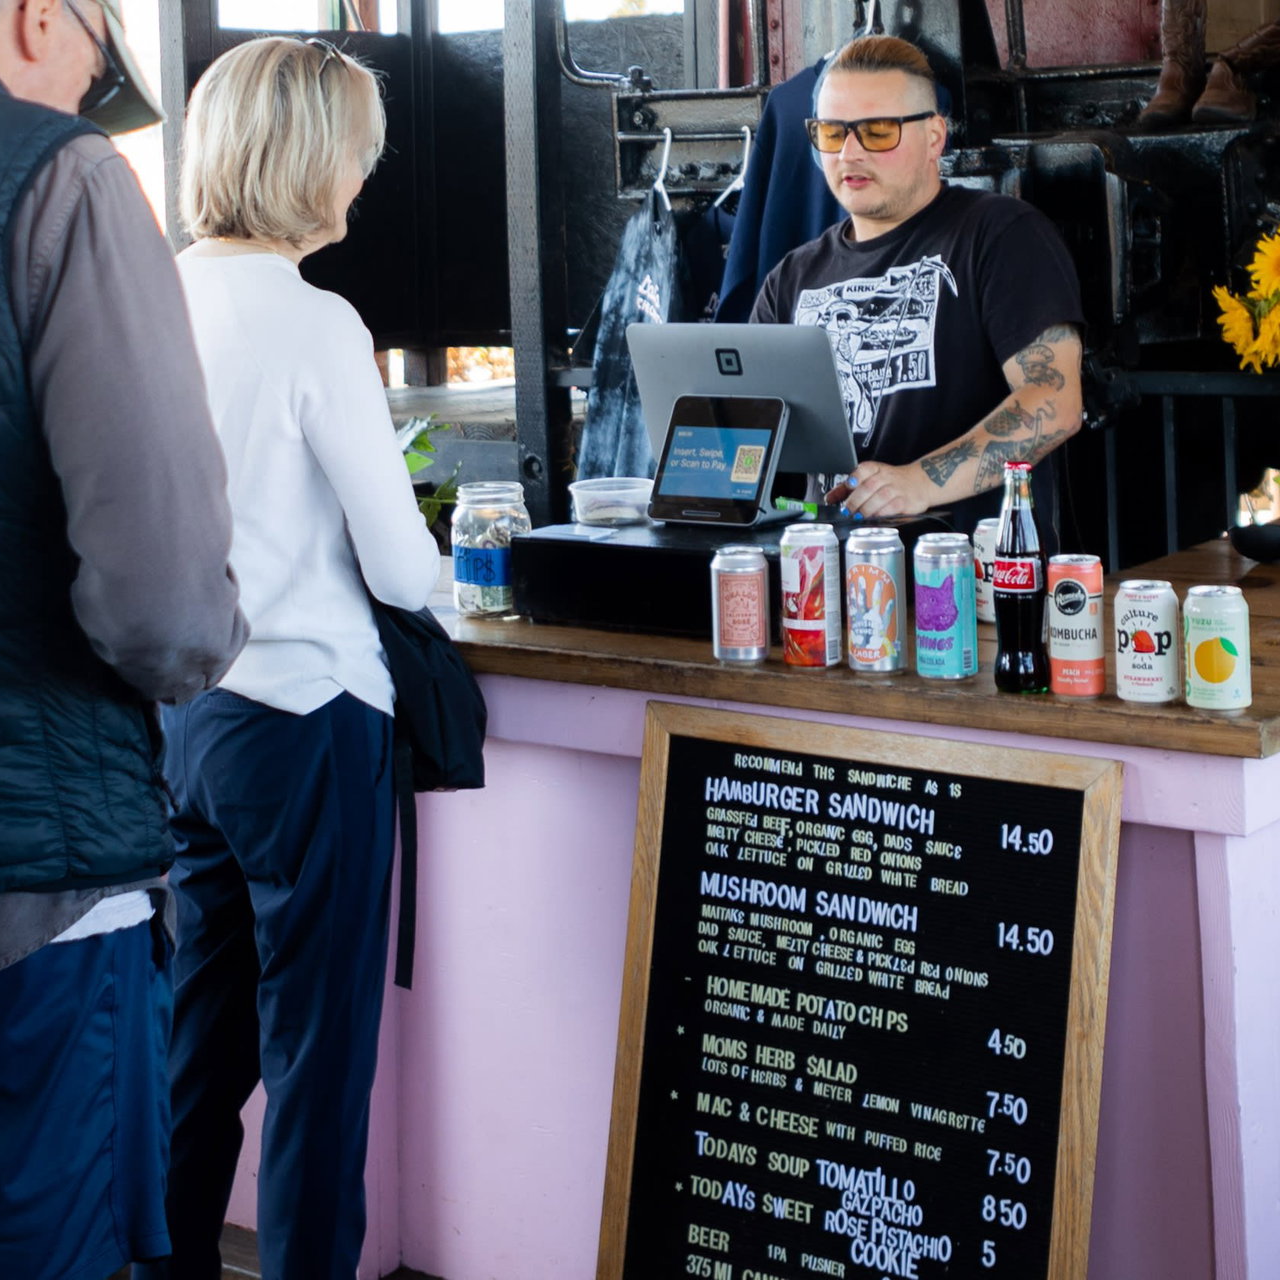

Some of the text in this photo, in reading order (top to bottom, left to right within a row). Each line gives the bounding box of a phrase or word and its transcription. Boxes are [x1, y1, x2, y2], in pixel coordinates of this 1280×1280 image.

[894, 351, 928, 384] 1.50
[1120, 608, 1159, 626] culture
[1131, 662, 1153, 670] soda
[812, 763, 834, 780] THE
[704, 776, 934, 835] HAMBURGER SANDWICH
[850, 846, 871, 862] RED
[883, 833, 912, 851] DADS
[1001, 823, 1053, 855] 14.50
[705, 841, 728, 857] OAK
[737, 846, 786, 866] LETTUCE
[796, 856, 813, 871] ON
[880, 868, 917, 887] WHITE
[930, 877, 968, 895] BREAD
[700, 870, 917, 932] MUSHROOM SANDWICH
[698, 921, 718, 936] DAD
[776, 934, 809, 953] MELTY
[811, 941, 854, 961] CHEESE
[855, 949, 863, 963] &
[945, 966, 988, 987] ONIONS
[829, 926, 883, 948] ORGANIC
[894, 937, 915, 955] EGG
[998, 921, 1053, 955] 14.50
[698, 939, 718, 954] OAK
[788, 955, 804, 971] ON
[868, 969, 904, 989] WHITE
[704, 998, 846, 1039] ORGANIC & MADE DAILY
[796, 992, 856, 1021] POTATO
[702, 1033, 857, 1083] MOMS HERB SALAD
[701, 1056, 727, 1074] LOTS
[731, 1063, 748, 1079] OF
[750, 1069, 786, 1087] HERBS
[794, 1077, 802, 1091] &
[813, 1081, 851, 1102] MEYER
[861, 1093, 899, 1113] LEMON
[696, 1092, 731, 1116] MAC
[739, 1102, 750, 1121] &
[756, 1106, 818, 1137] CHEESE
[864, 1130, 907, 1152] PUFFED
[986, 1090, 1027, 1125] 7.50
[694, 1130, 915, 1202] TODAYS SOUP TOMATILLO
[986, 1148, 1031, 1184] 7.50
[690, 1175, 755, 1210] TODAYS
[762, 1193, 813, 1223] SWEET
[870, 1217, 951, 1263] PISTACHIO
[841, 1189, 923, 1227] GAZPACHO
[687, 1223, 730, 1253] BEER
[981, 1239, 995, 1267] 5
[851, 1237, 919, 1280] COOKIE
